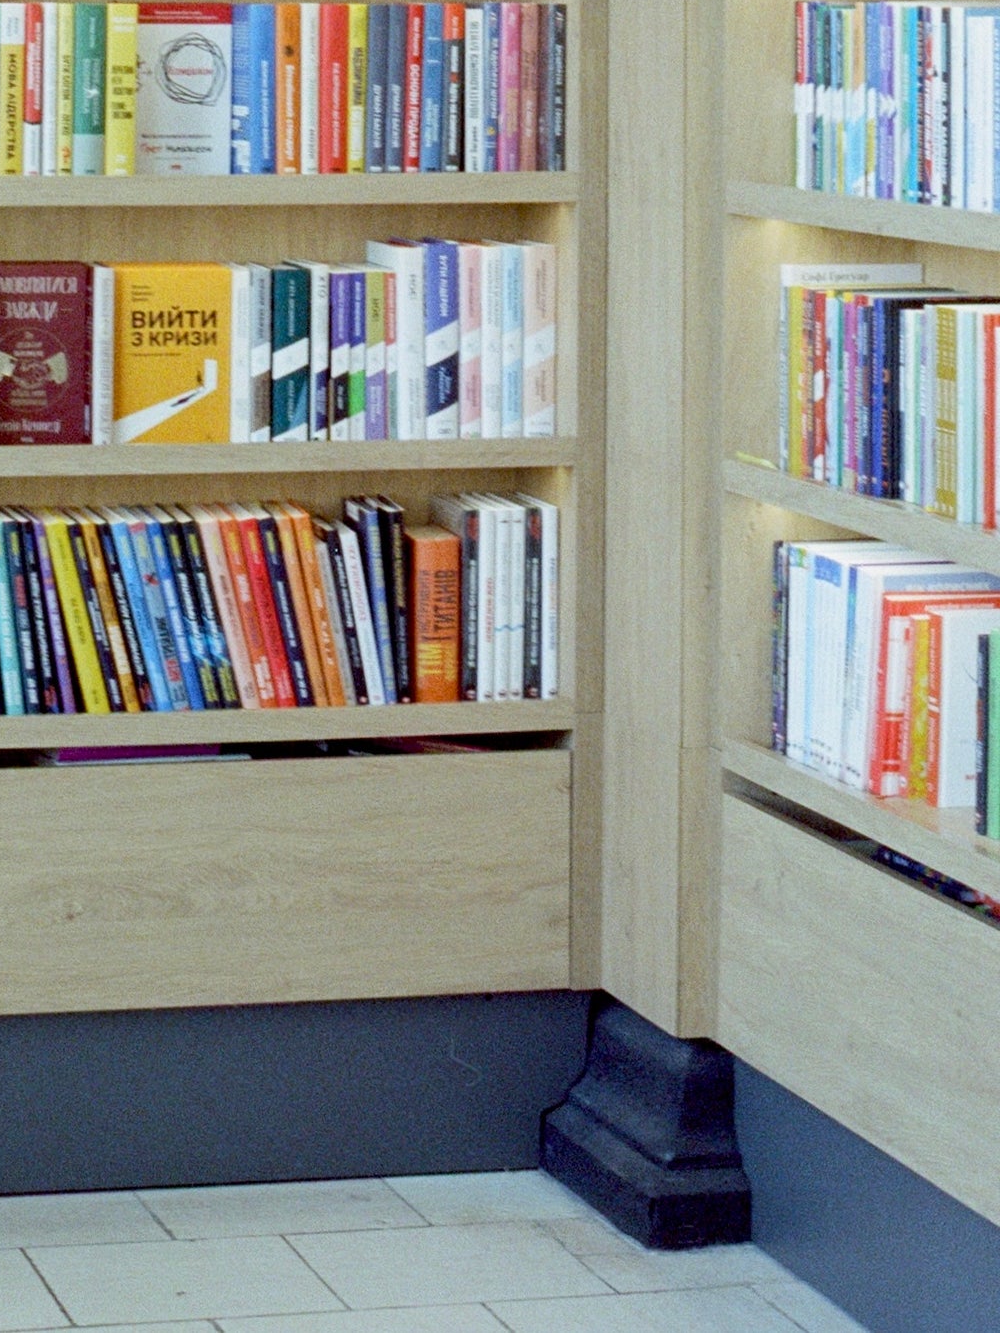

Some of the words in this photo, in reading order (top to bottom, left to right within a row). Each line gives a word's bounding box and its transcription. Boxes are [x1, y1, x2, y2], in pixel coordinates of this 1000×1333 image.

[6, 53, 17, 88] МОВА
[409, 64, 420, 105] ОСНОВИ
[6, 93, 17, 159] ЛІДЕРСТВА
[131, 305, 218, 329] ВИЙТИ
[149, 332, 218, 347] КРИЗИ
[434, 570, 457, 634] ТИТАНІВ
[417, 642, 443, 679] ТІМ
